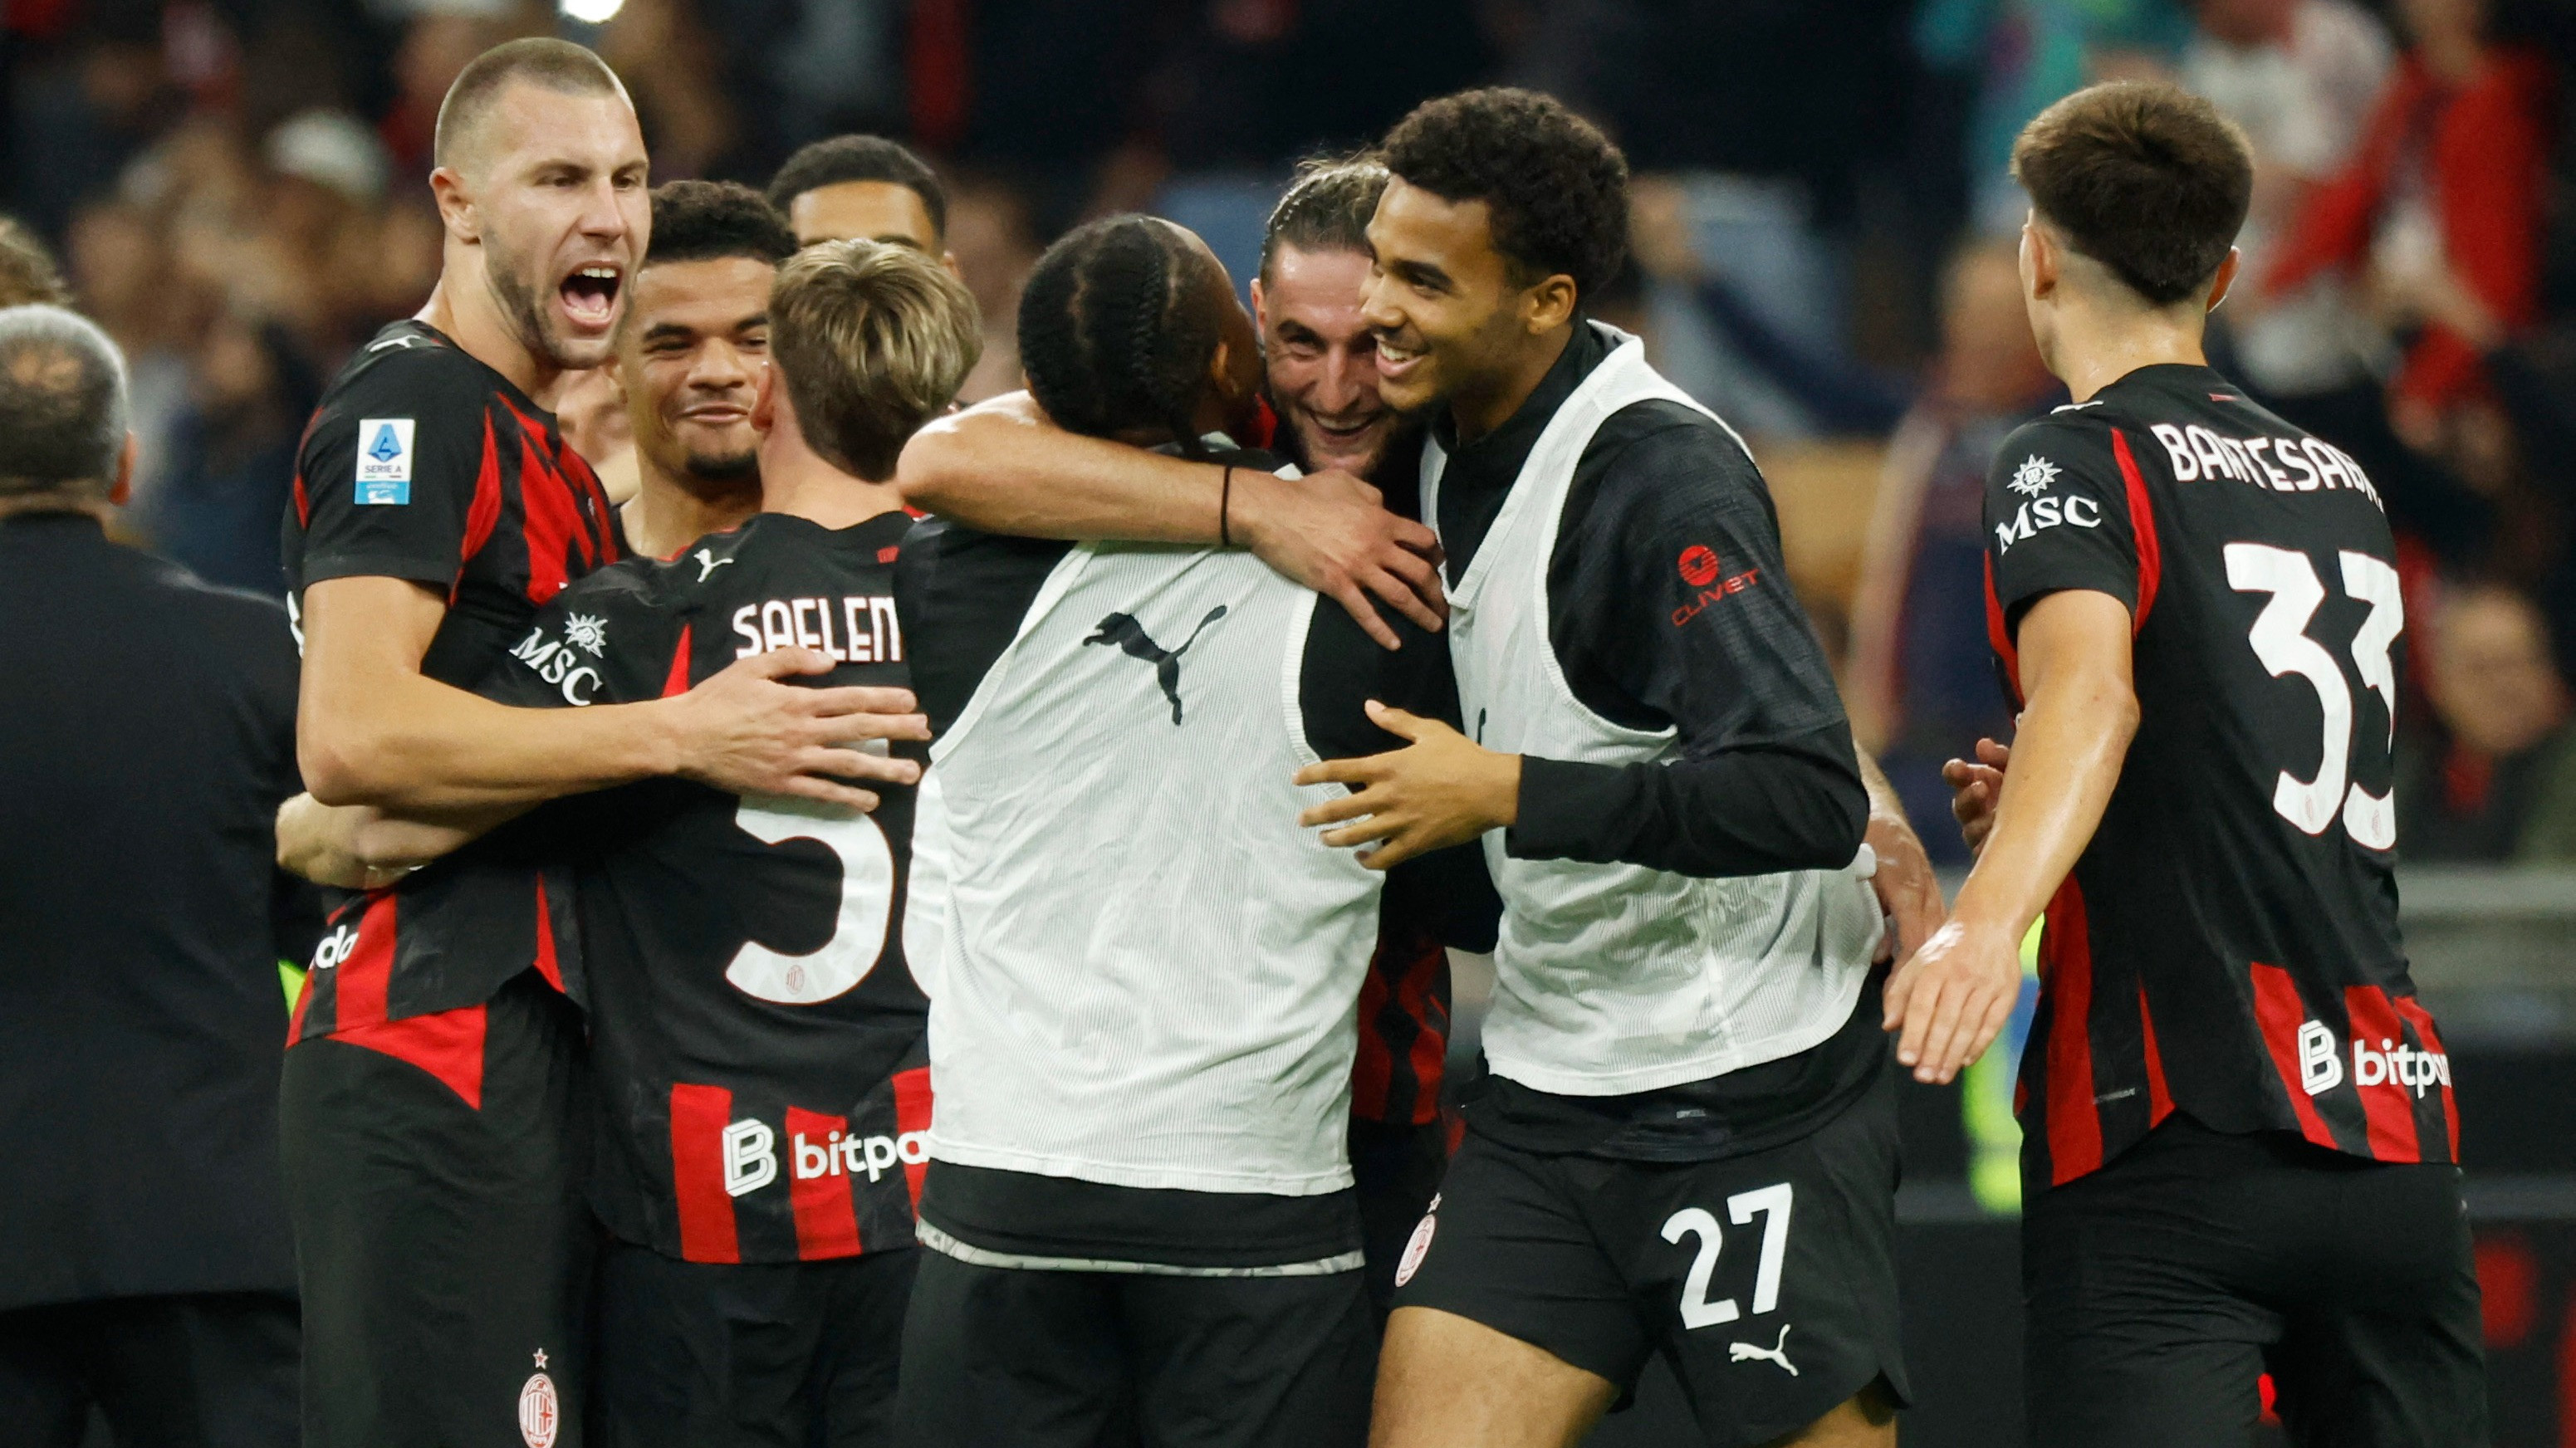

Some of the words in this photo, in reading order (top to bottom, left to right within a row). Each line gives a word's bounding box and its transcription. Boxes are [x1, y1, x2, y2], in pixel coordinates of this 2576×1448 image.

[365, 465, 392, 473] SERIE
[395, 465, 402, 473] A
[1995, 495, 2102, 556] MSC
[1671, 567, 1761, 628] CLIVET
[508, 626, 604, 707] MSC
[2222, 541, 2405, 851] 33
[1660, 1181, 1794, 1330] 27
